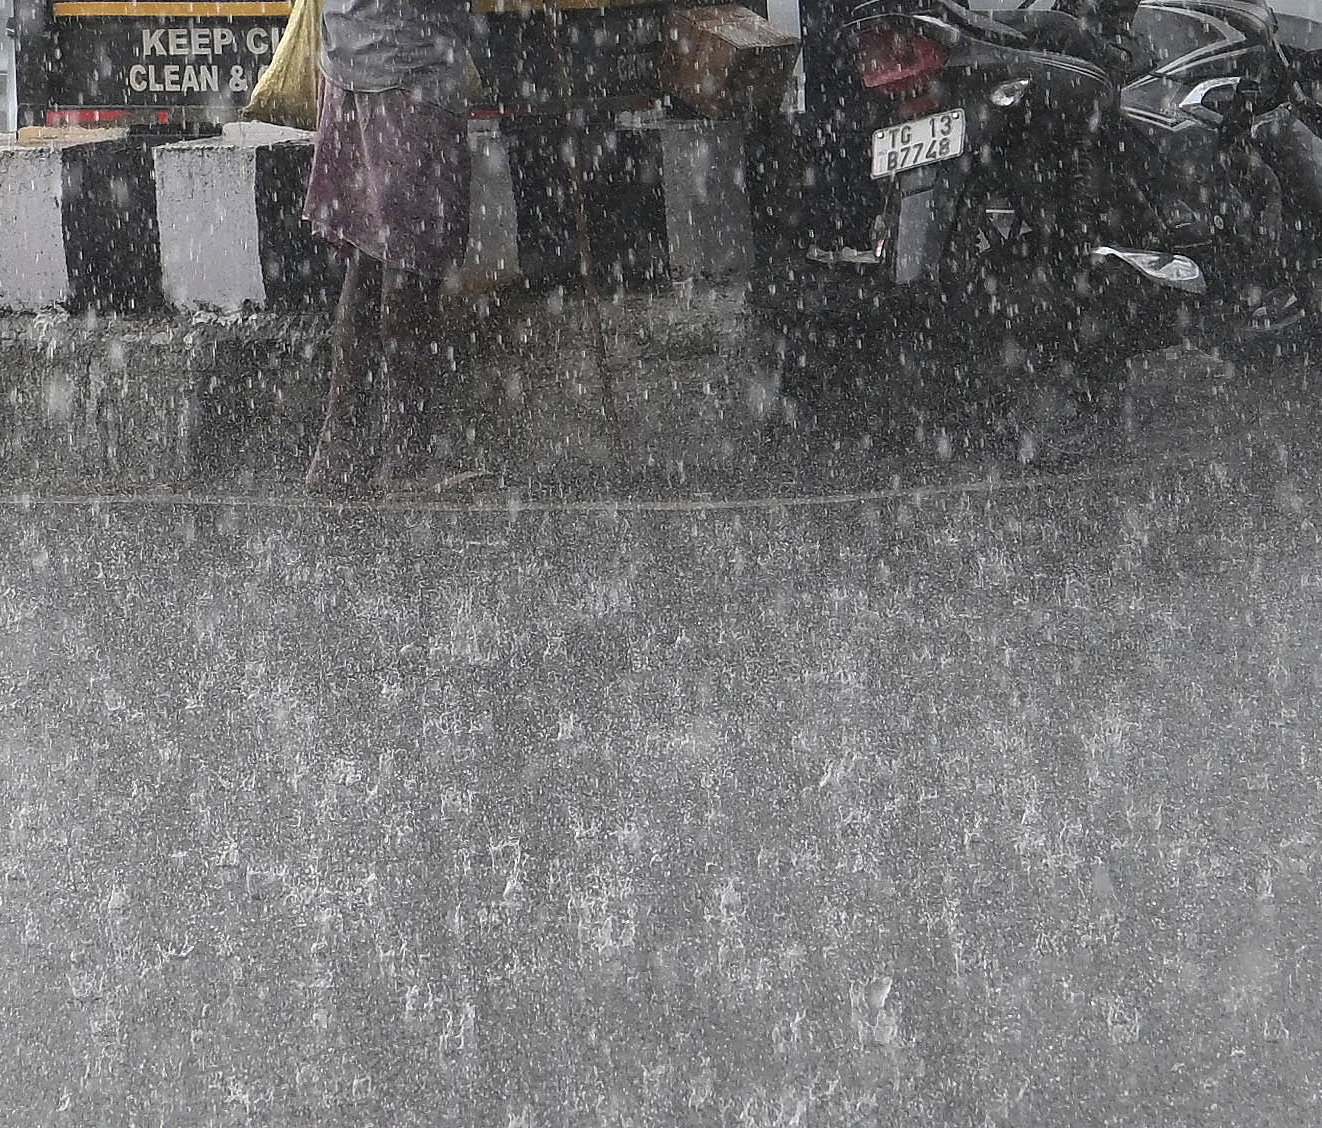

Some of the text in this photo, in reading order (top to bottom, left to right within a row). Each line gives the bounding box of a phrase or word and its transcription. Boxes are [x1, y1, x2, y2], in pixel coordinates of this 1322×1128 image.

[142, 28, 233, 56] KEEP
[130, 64, 219, 92] CLEAN
[229, 65, 248, 92] &
[889, 115, 952, 149] TG 13
[887, 137, 951, 171] B7748
